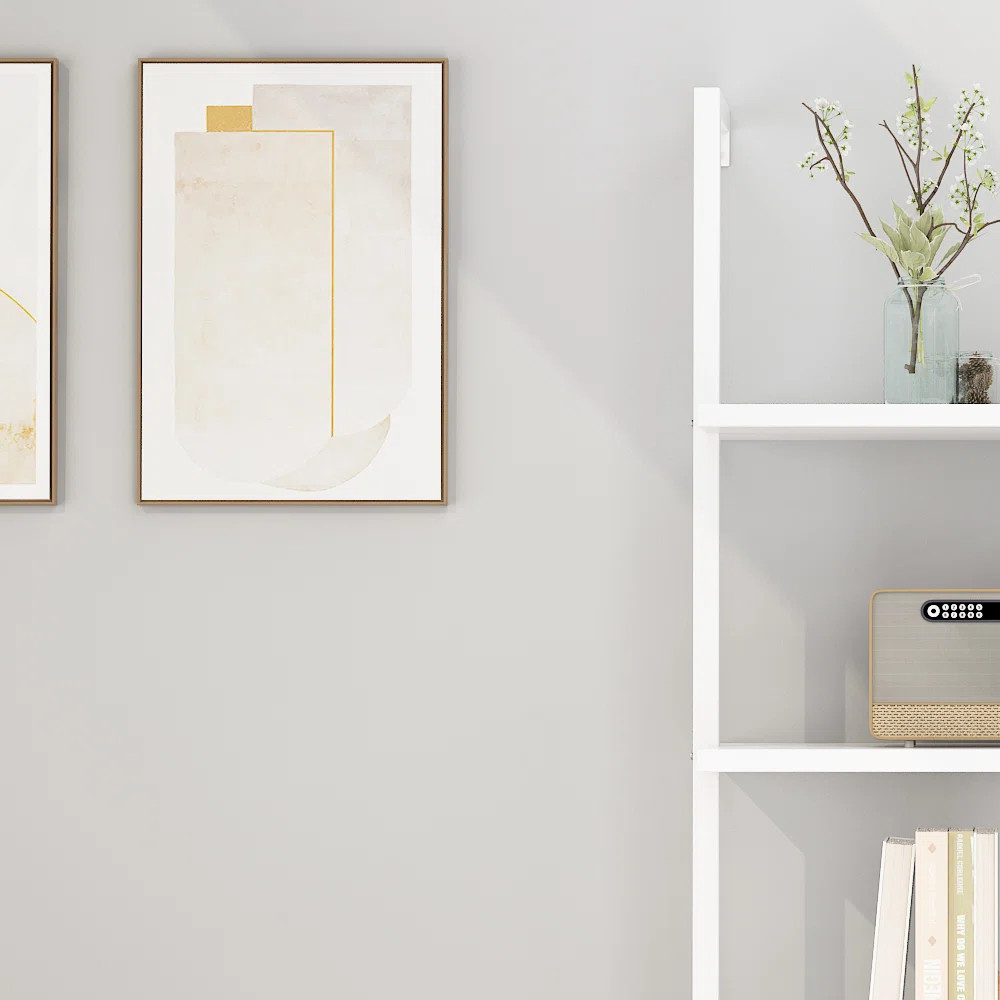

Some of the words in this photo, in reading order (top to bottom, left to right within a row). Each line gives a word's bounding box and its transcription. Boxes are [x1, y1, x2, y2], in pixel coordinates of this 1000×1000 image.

[956, 914, 966, 936] WHY
[956, 937, 966, 951] DO
[956, 952, 966, 968] WE
[956, 969, 966, 992] LOVE
